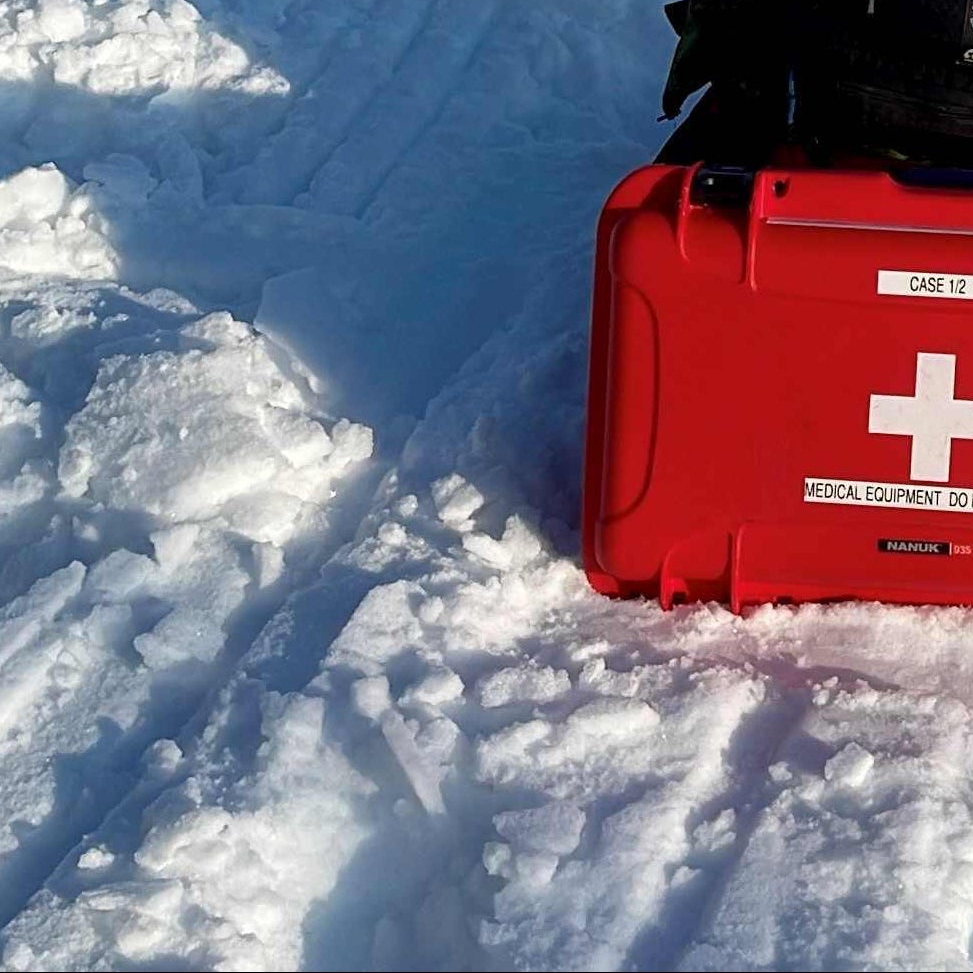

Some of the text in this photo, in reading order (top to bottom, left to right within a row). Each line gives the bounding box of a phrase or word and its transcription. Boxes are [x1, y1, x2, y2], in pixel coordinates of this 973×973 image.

[909, 276, 967, 295] CASE 1/2
[805, 482, 862, 501] MEDICAL
[865, 486, 942, 506] EQUIPMENT
[949, 491, 968, 508] DO
[886, 541, 940, 553] NANUK
